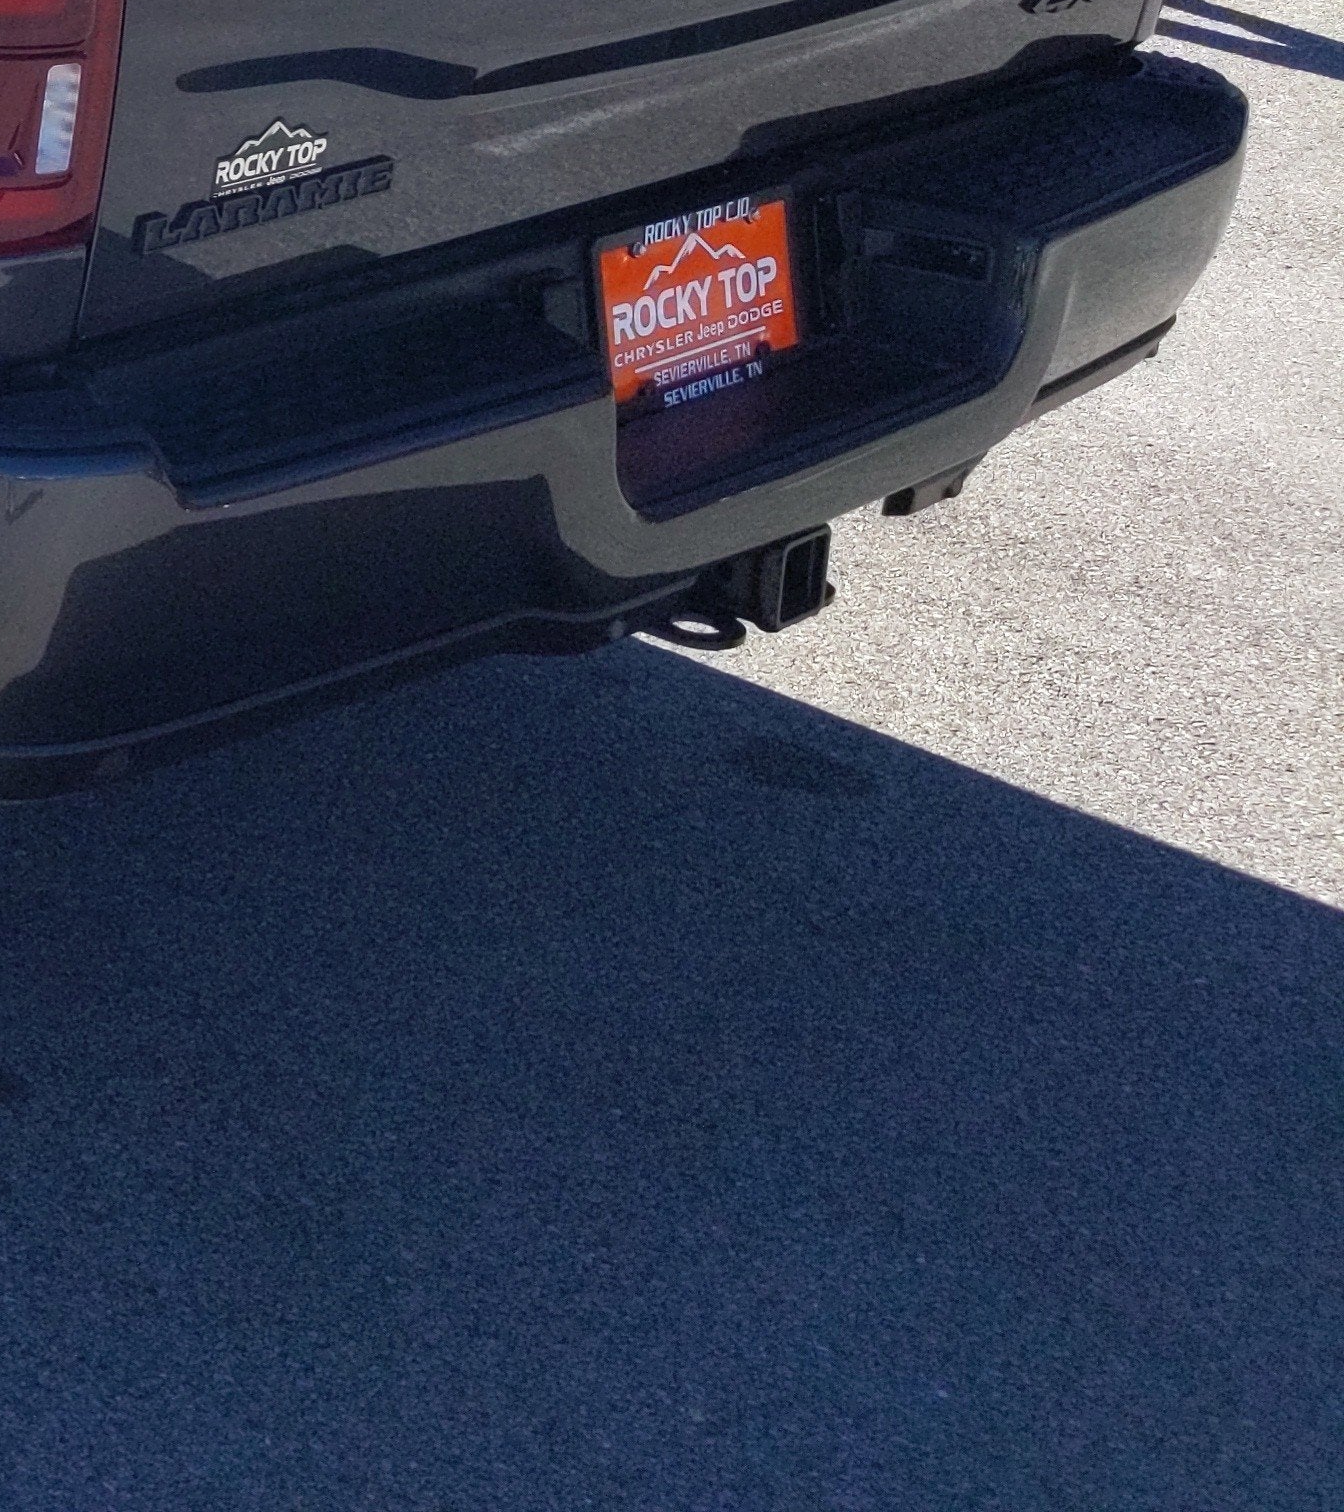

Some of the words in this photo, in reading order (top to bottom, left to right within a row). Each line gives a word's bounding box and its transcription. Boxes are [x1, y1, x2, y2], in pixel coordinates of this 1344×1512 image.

[215, 147, 284, 184] ROCKY
[287, 138, 327, 167] TOP
[131, 154, 394, 255] LARAMIE
[644, 214, 691, 246] ROCKY
[696, 205, 722, 230] TOP
[612, 275, 713, 345] ROCKY
[718, 256, 777, 309] TOP
[614, 330, 694, 368] CHRYSLER
[697, 320, 725, 341] Jeep
[727, 299, 783, 329] DODGE
[653, 349, 732, 387] SEVIERVILLE,
[735, 342, 751, 359] TN
[664, 368, 744, 408] SEVIERVILLE,
[746, 360, 763, 376] TN
